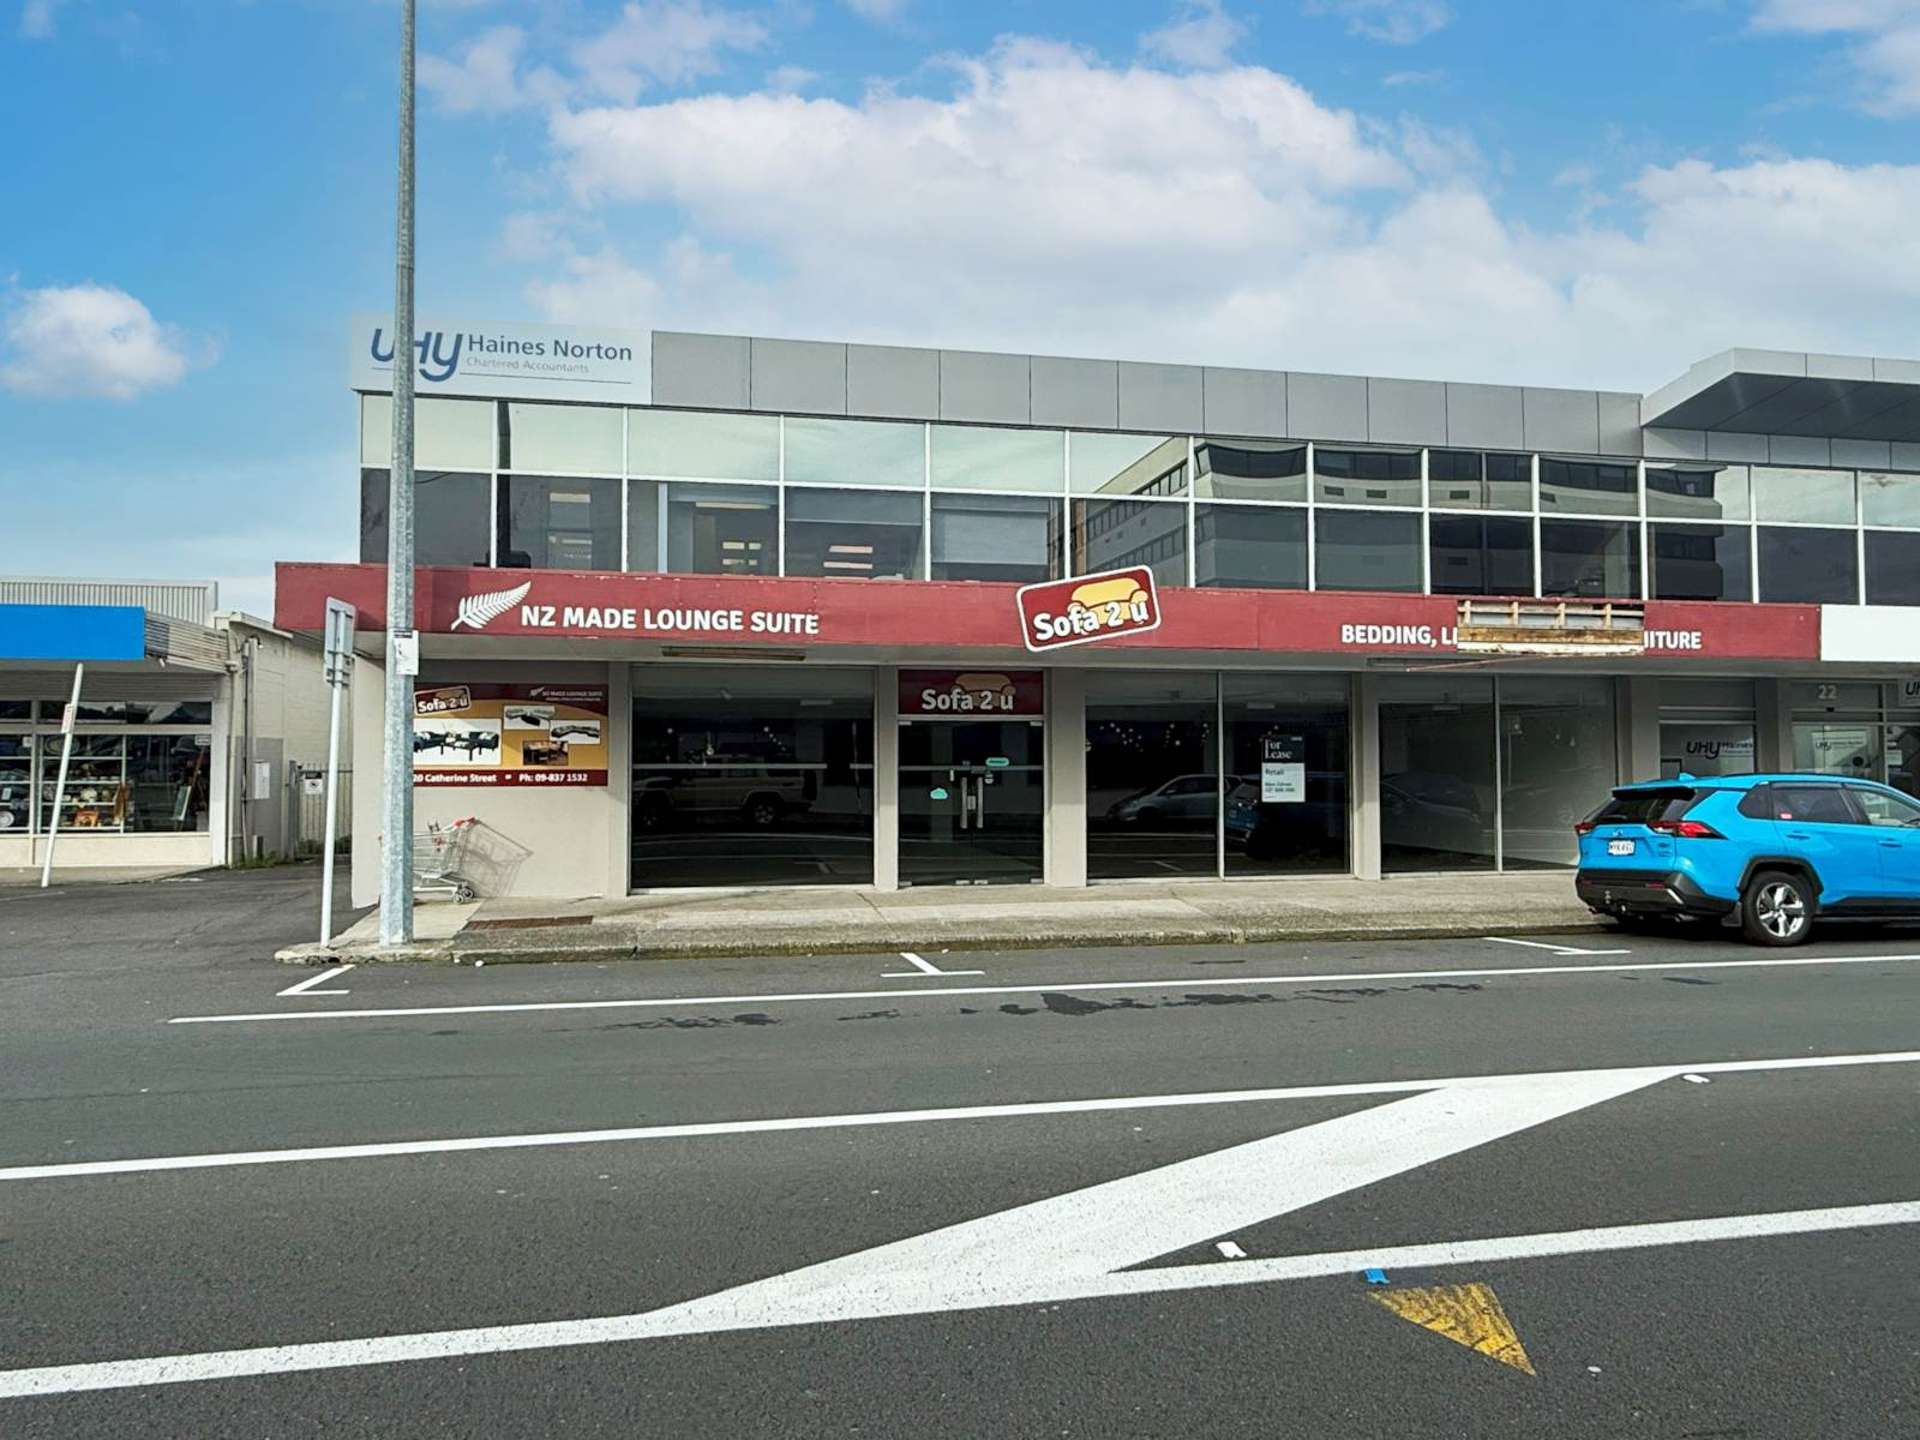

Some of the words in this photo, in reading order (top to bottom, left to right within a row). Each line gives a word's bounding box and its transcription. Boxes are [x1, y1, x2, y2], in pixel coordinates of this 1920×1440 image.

[468, 334, 545, 356] Haines
[554, 339, 633, 361] Norton
[466, 356, 520, 370] Chartered
[523, 360, 590, 374] Accountants
[521, 605, 556, 627] NZ
[563, 607, 637, 629] MADE
[644, 609, 744, 631] LOUNGE
[751, 612, 819, 634] SUITE
[1033, 604, 1100, 641] Sofa
[1105, 601, 1124, 627] 2
[1130, 600, 1149, 622] u
[1341, 624, 1437, 648] BEDDING,
[921, 688, 973, 710] Sofa
[980, 690, 993, 710] 2
[1001, 694, 1014, 710] u
[1818, 685, 1838, 699] 22
[418, 698, 447, 712] Sofa
[448, 698, 456, 708] 2
[1265, 749, 1293, 759] Lease
[425, 773, 468, 783] Catherine
[470, 773, 497, 783] Street
